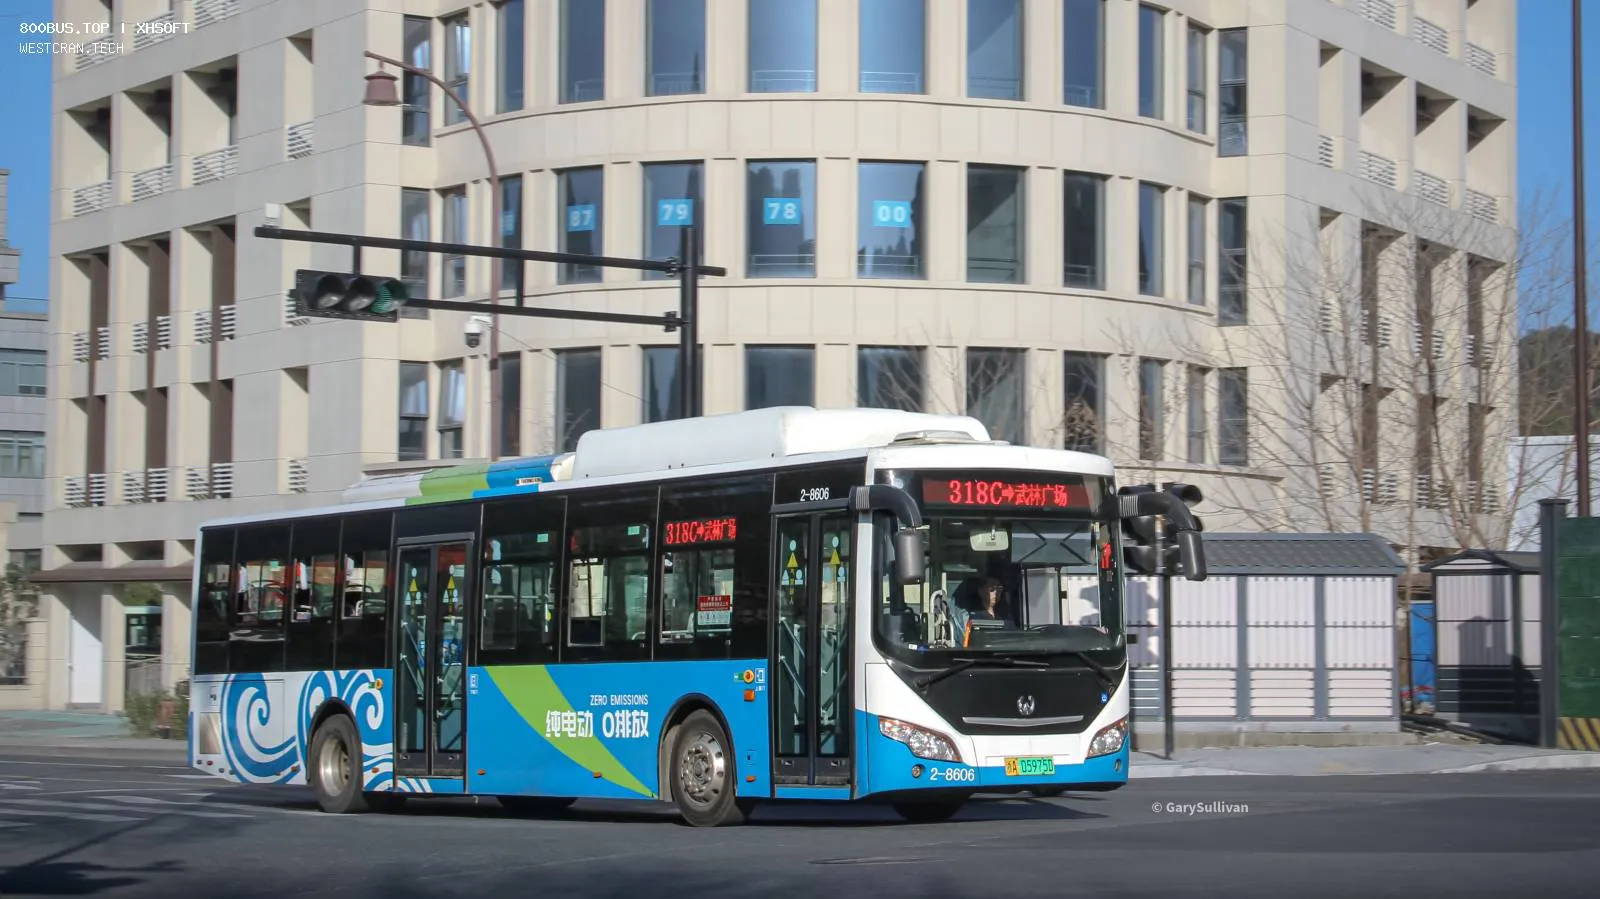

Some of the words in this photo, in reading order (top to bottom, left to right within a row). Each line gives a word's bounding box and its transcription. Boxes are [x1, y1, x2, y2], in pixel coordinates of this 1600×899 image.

[569, 209, 593, 227] 87
[662, 203, 689, 221] 79
[767, 202, 797, 220] 78
[877, 204, 907, 223] 00
[800, 487, 829, 502] 2-8606
[949, 479, 1002, 505] 318C
[1015, 483, 1068, 507] 武林广场
[666, 520, 698, 545] 318C
[590, 694, 608, 706] ZERO
[610, 694, 649, 706] EMISSIONS
[545, 709, 594, 738] 纯电动
[929, 767, 975, 781] 2-8606
